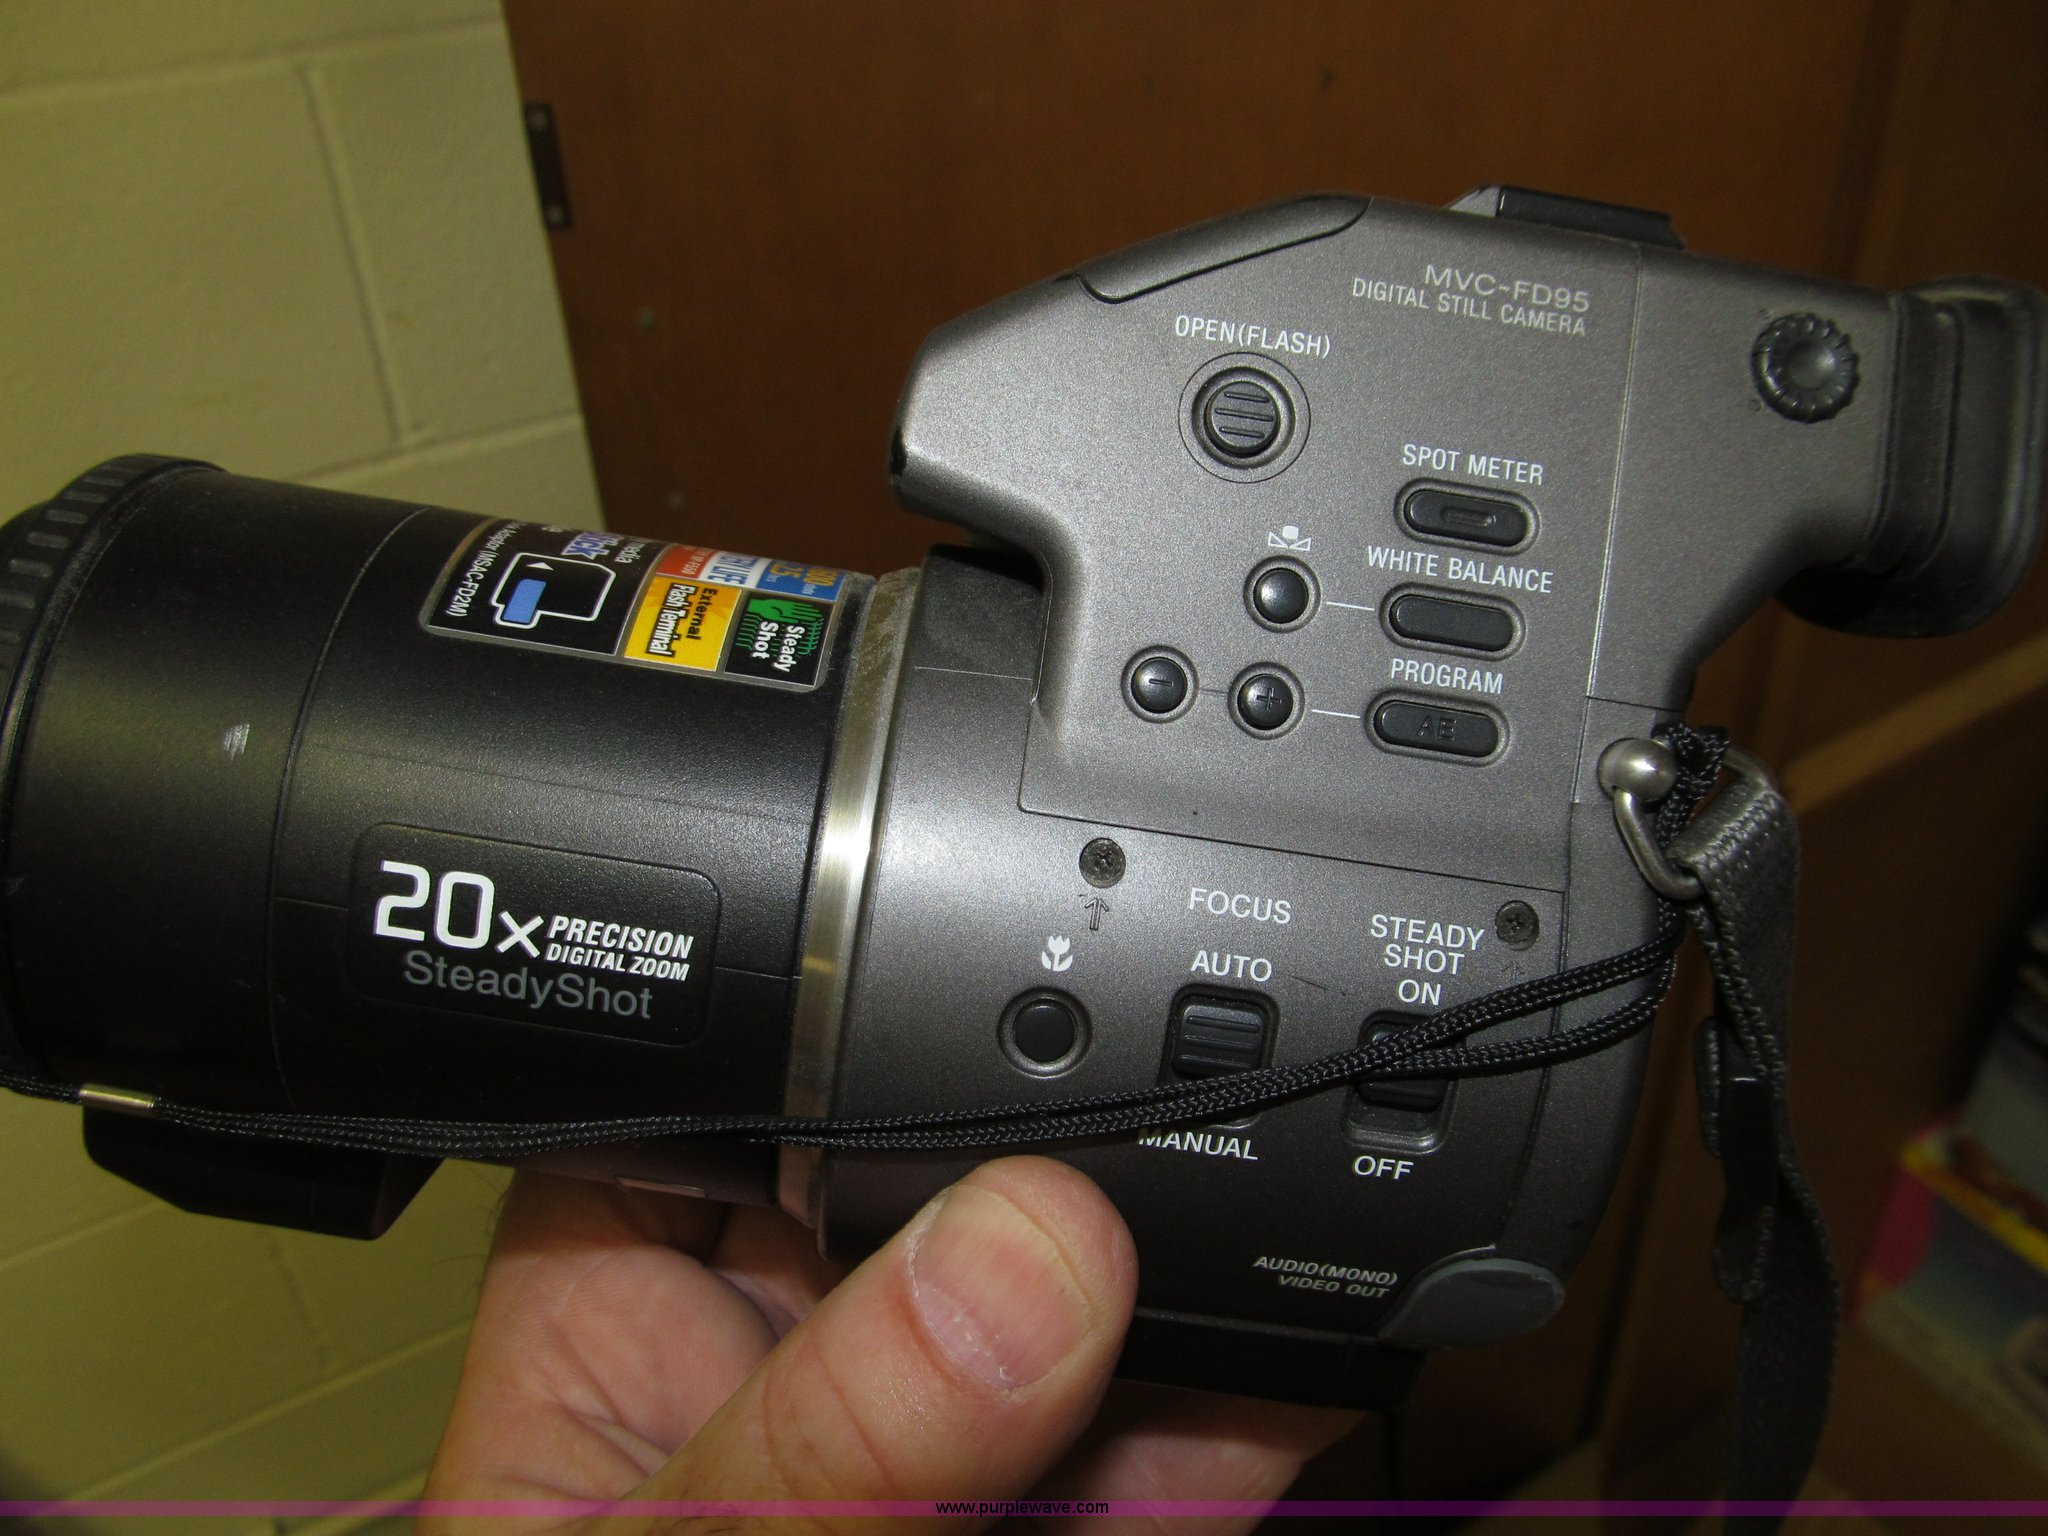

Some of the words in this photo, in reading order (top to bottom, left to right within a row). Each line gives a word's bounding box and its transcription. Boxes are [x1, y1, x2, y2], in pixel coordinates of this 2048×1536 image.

[1352, 277, 1430, 310] DIGITAL
[1437, 293, 1492, 321] STILL
[1501, 304, 1587, 337] CAMERA
[1425, 264, 1591, 313] MVC-FD95
[1174, 314, 1332, 360] OPEN(FLASH)
[1402, 444, 1460, 472] SPOT
[1468, 454, 1543, 486] METER
[707, 565, 752, 585] LIFE
[1367, 545, 1439, 578] WHITE
[1448, 557, 1554, 594] BALANCE
[664, 582, 697, 613] Flash
[687, 587, 719, 641] External
[648, 607, 688, 656] Terminal
[752, 620, 780, 661] Shot
[773, 624, 806, 673] Steady
[1390, 658, 1504, 695] PROGRAM
[1189, 887, 1292, 924] FOCUS
[547, 915, 694, 959] PRECISION
[1371, 914, 1486, 951] STEADY
[545, 943, 625, 973] DIGITAL
[631, 957, 690, 982] ZOOM
[1191, 950, 1273, 982] AUTO
[1384, 945, 1465, 976] SHOT
[403, 950, 653, 1019] SteadyShot
[1398, 979, 1442, 1006] ON
[1354, 1155, 1414, 1180] OFF
[1253, 1256, 1398, 1286] AUDIO(MONO)
[1278, 1275, 1340, 1293] VIDEO
[1345, 1284, 1391, 1299] OUT
